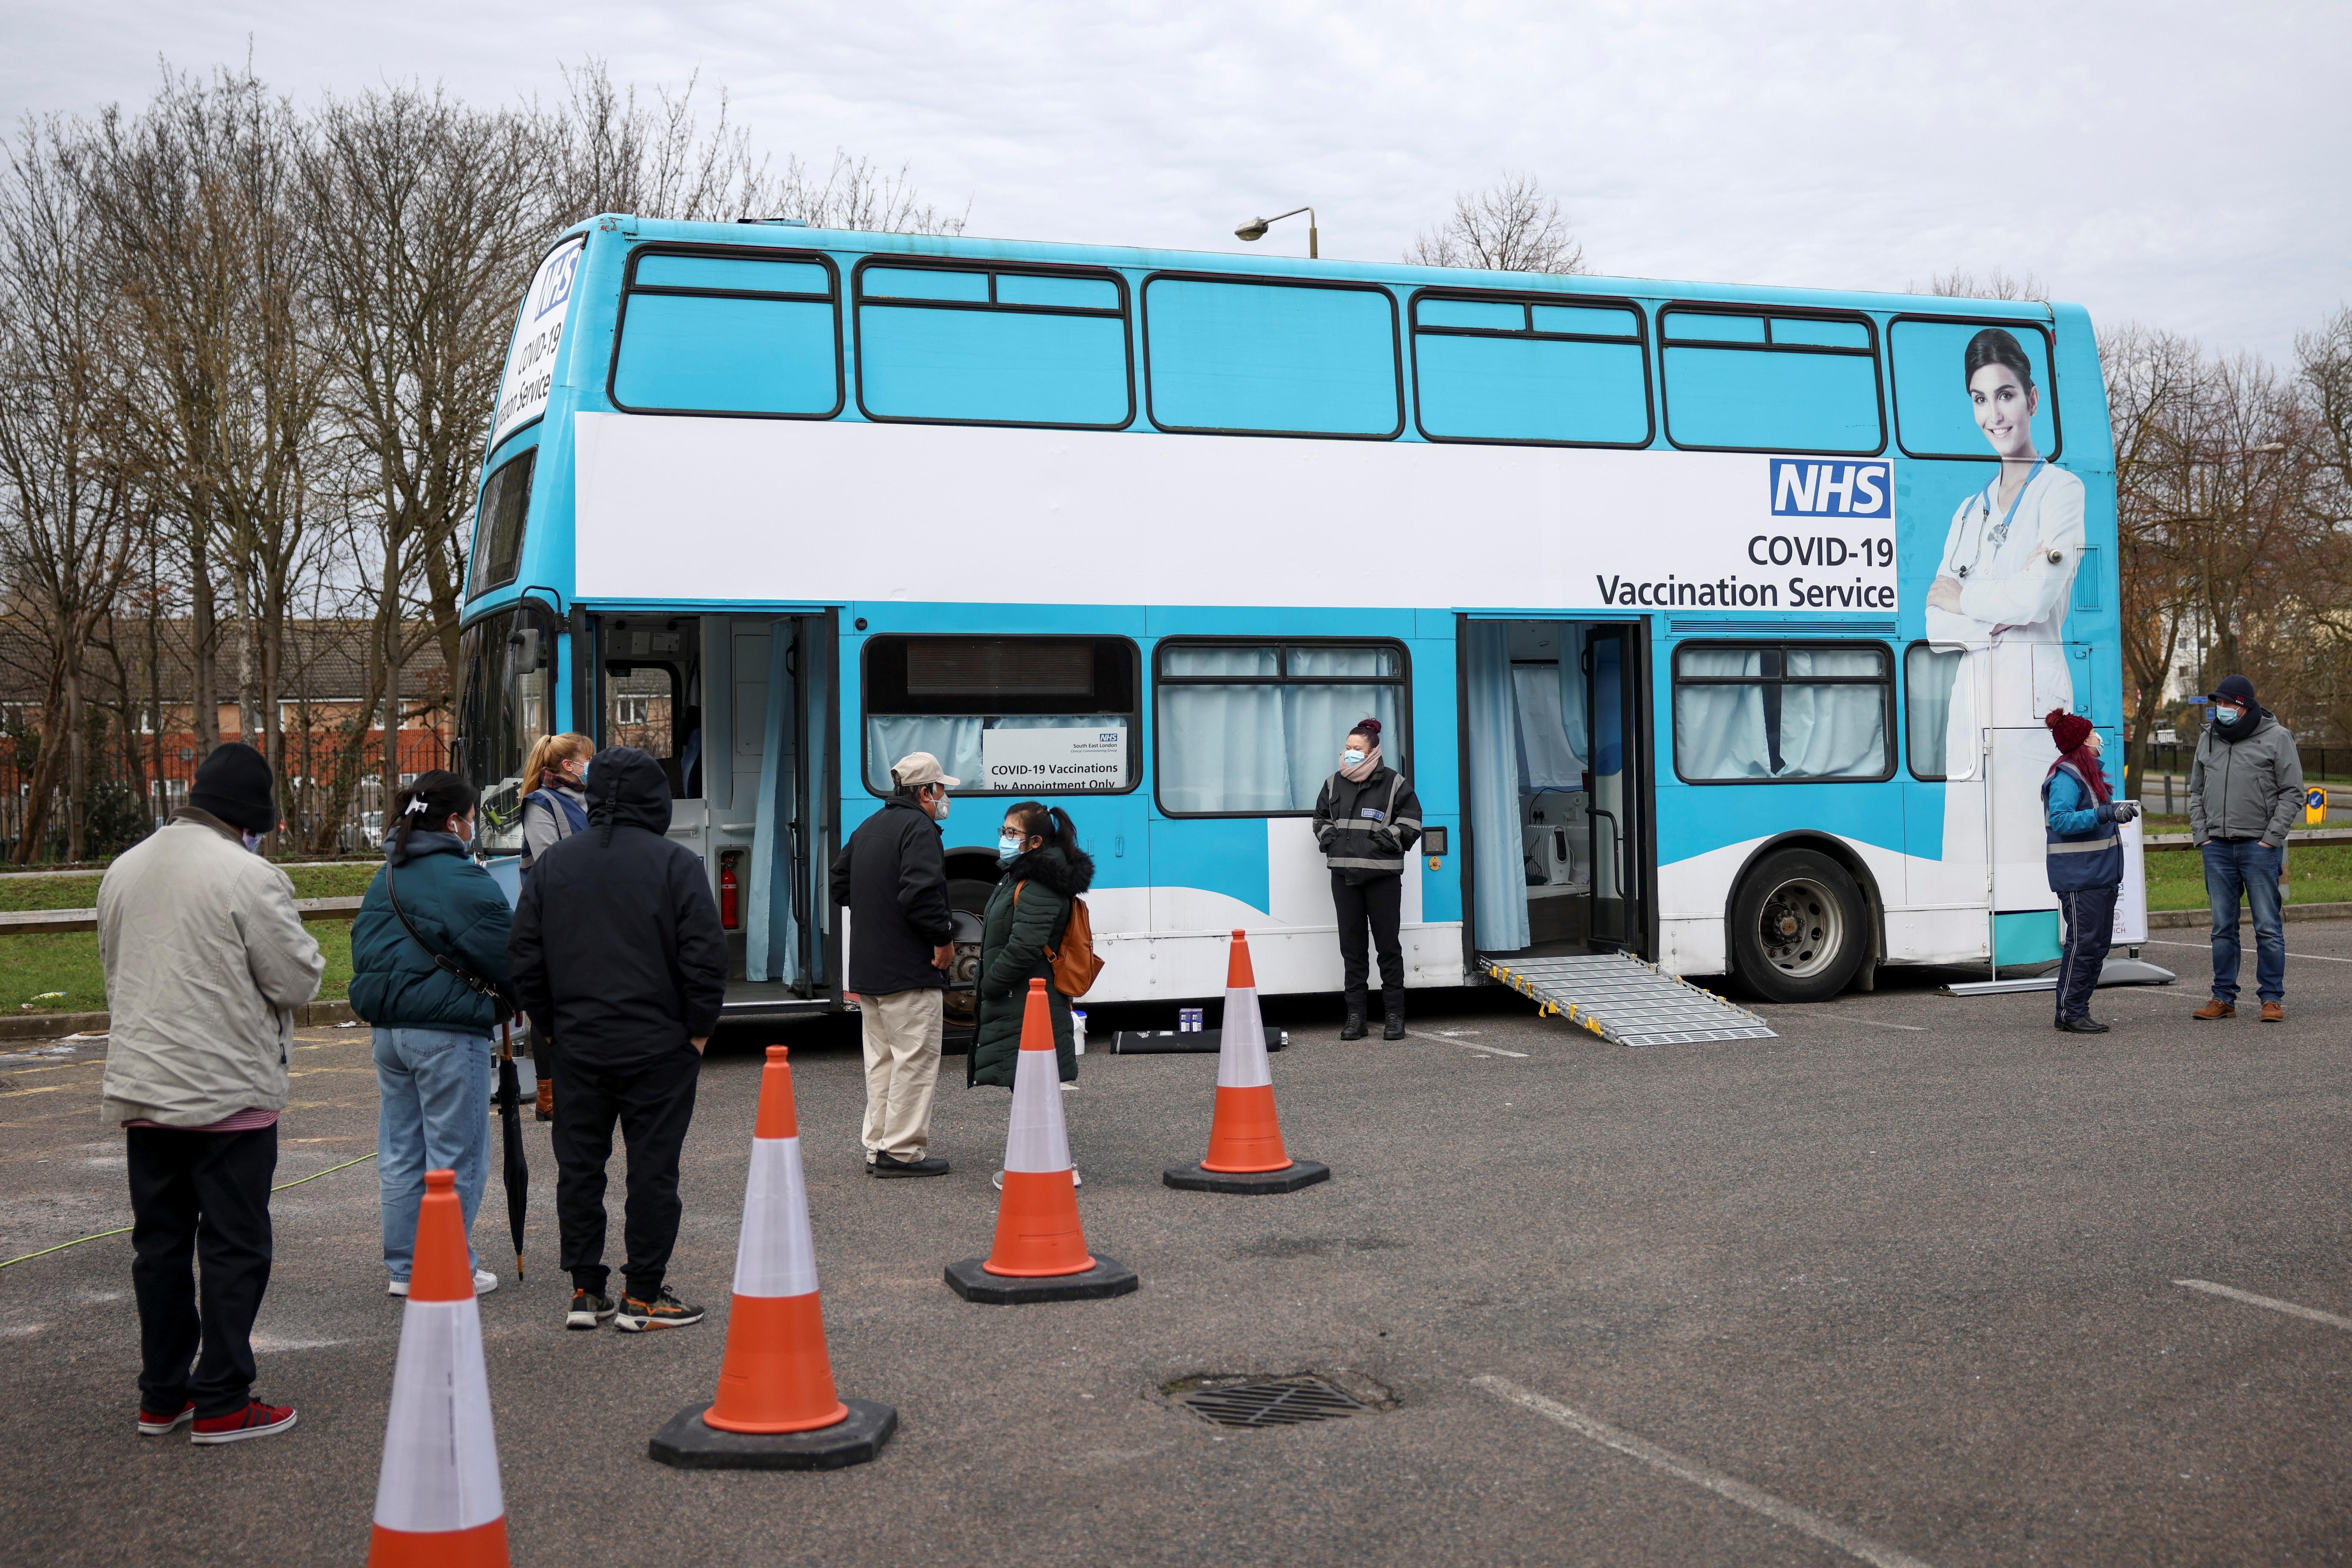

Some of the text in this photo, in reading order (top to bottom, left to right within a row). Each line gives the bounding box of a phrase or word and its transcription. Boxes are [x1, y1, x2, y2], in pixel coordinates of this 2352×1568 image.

[537, 247, 579, 317] NHS
[518, 322, 561, 375] COVID-19
[517, 369, 550, 412] Service
[1774, 464, 1885, 514] NHS
[1748, 535, 1893, 567] COVID-19
[1596, 575, 1894, 608] Vaccination Service
[991, 763, 1118, 775] COVID-19 Vaccinations
